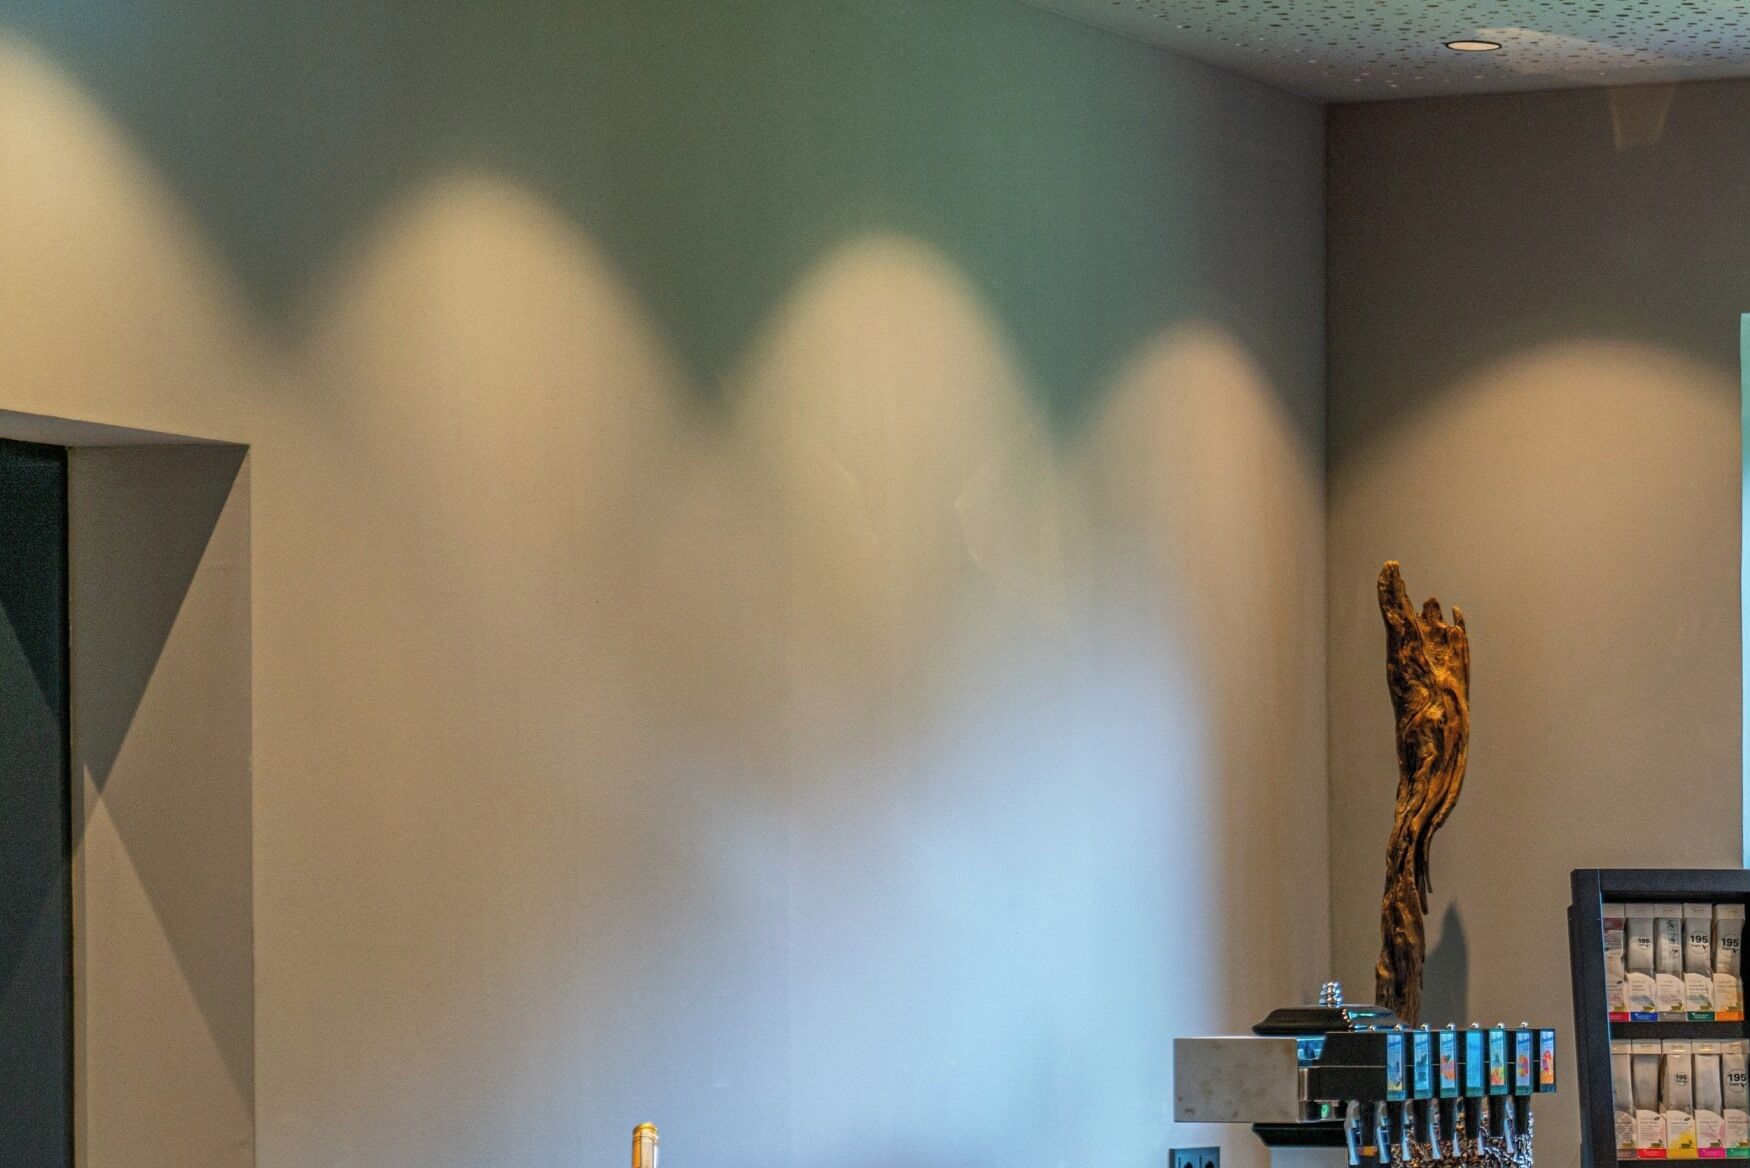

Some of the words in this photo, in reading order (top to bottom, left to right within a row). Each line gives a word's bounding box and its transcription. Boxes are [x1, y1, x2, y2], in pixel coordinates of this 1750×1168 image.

[1690, 935, 1709, 944] 195
[1721, 938, 1739, 947] 195
[1728, 1073, 1747, 1082] 195
